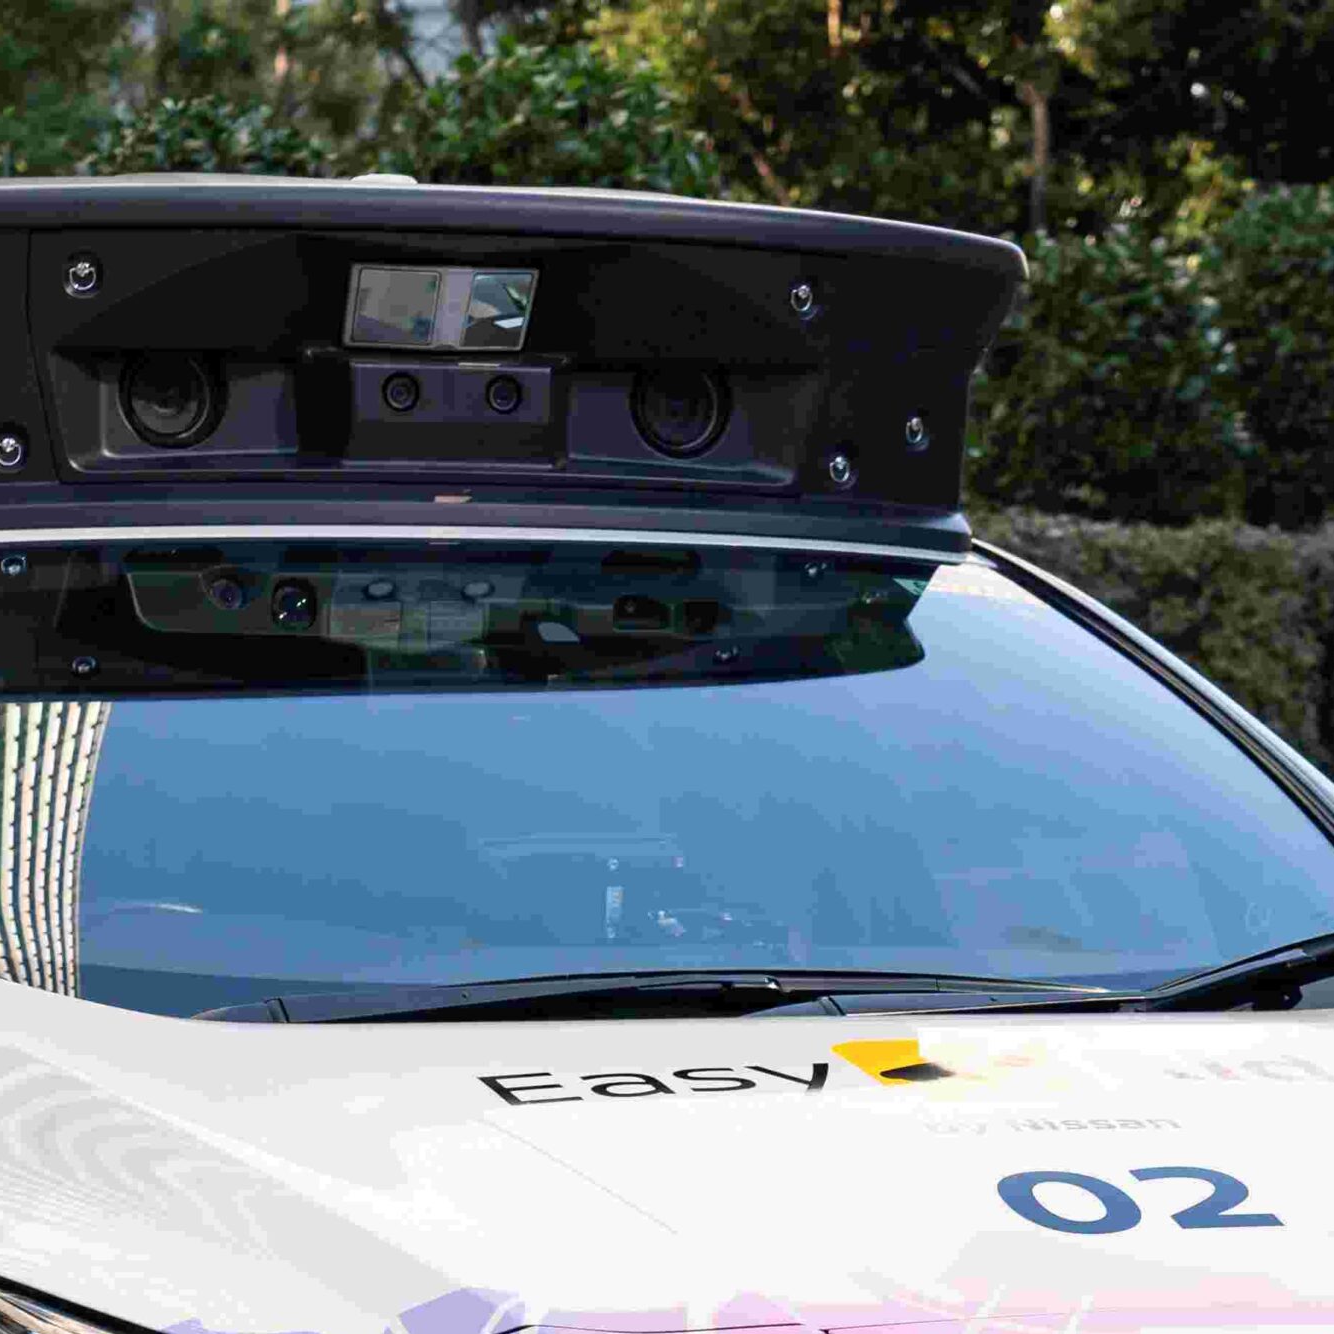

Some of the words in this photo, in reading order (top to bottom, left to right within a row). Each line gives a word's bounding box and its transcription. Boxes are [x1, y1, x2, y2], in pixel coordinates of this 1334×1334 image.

[478, 1062, 829, 1106] Easy
[1005, 1116, 1183, 1135] Nissan
[996, 1166, 1285, 1235] 02
